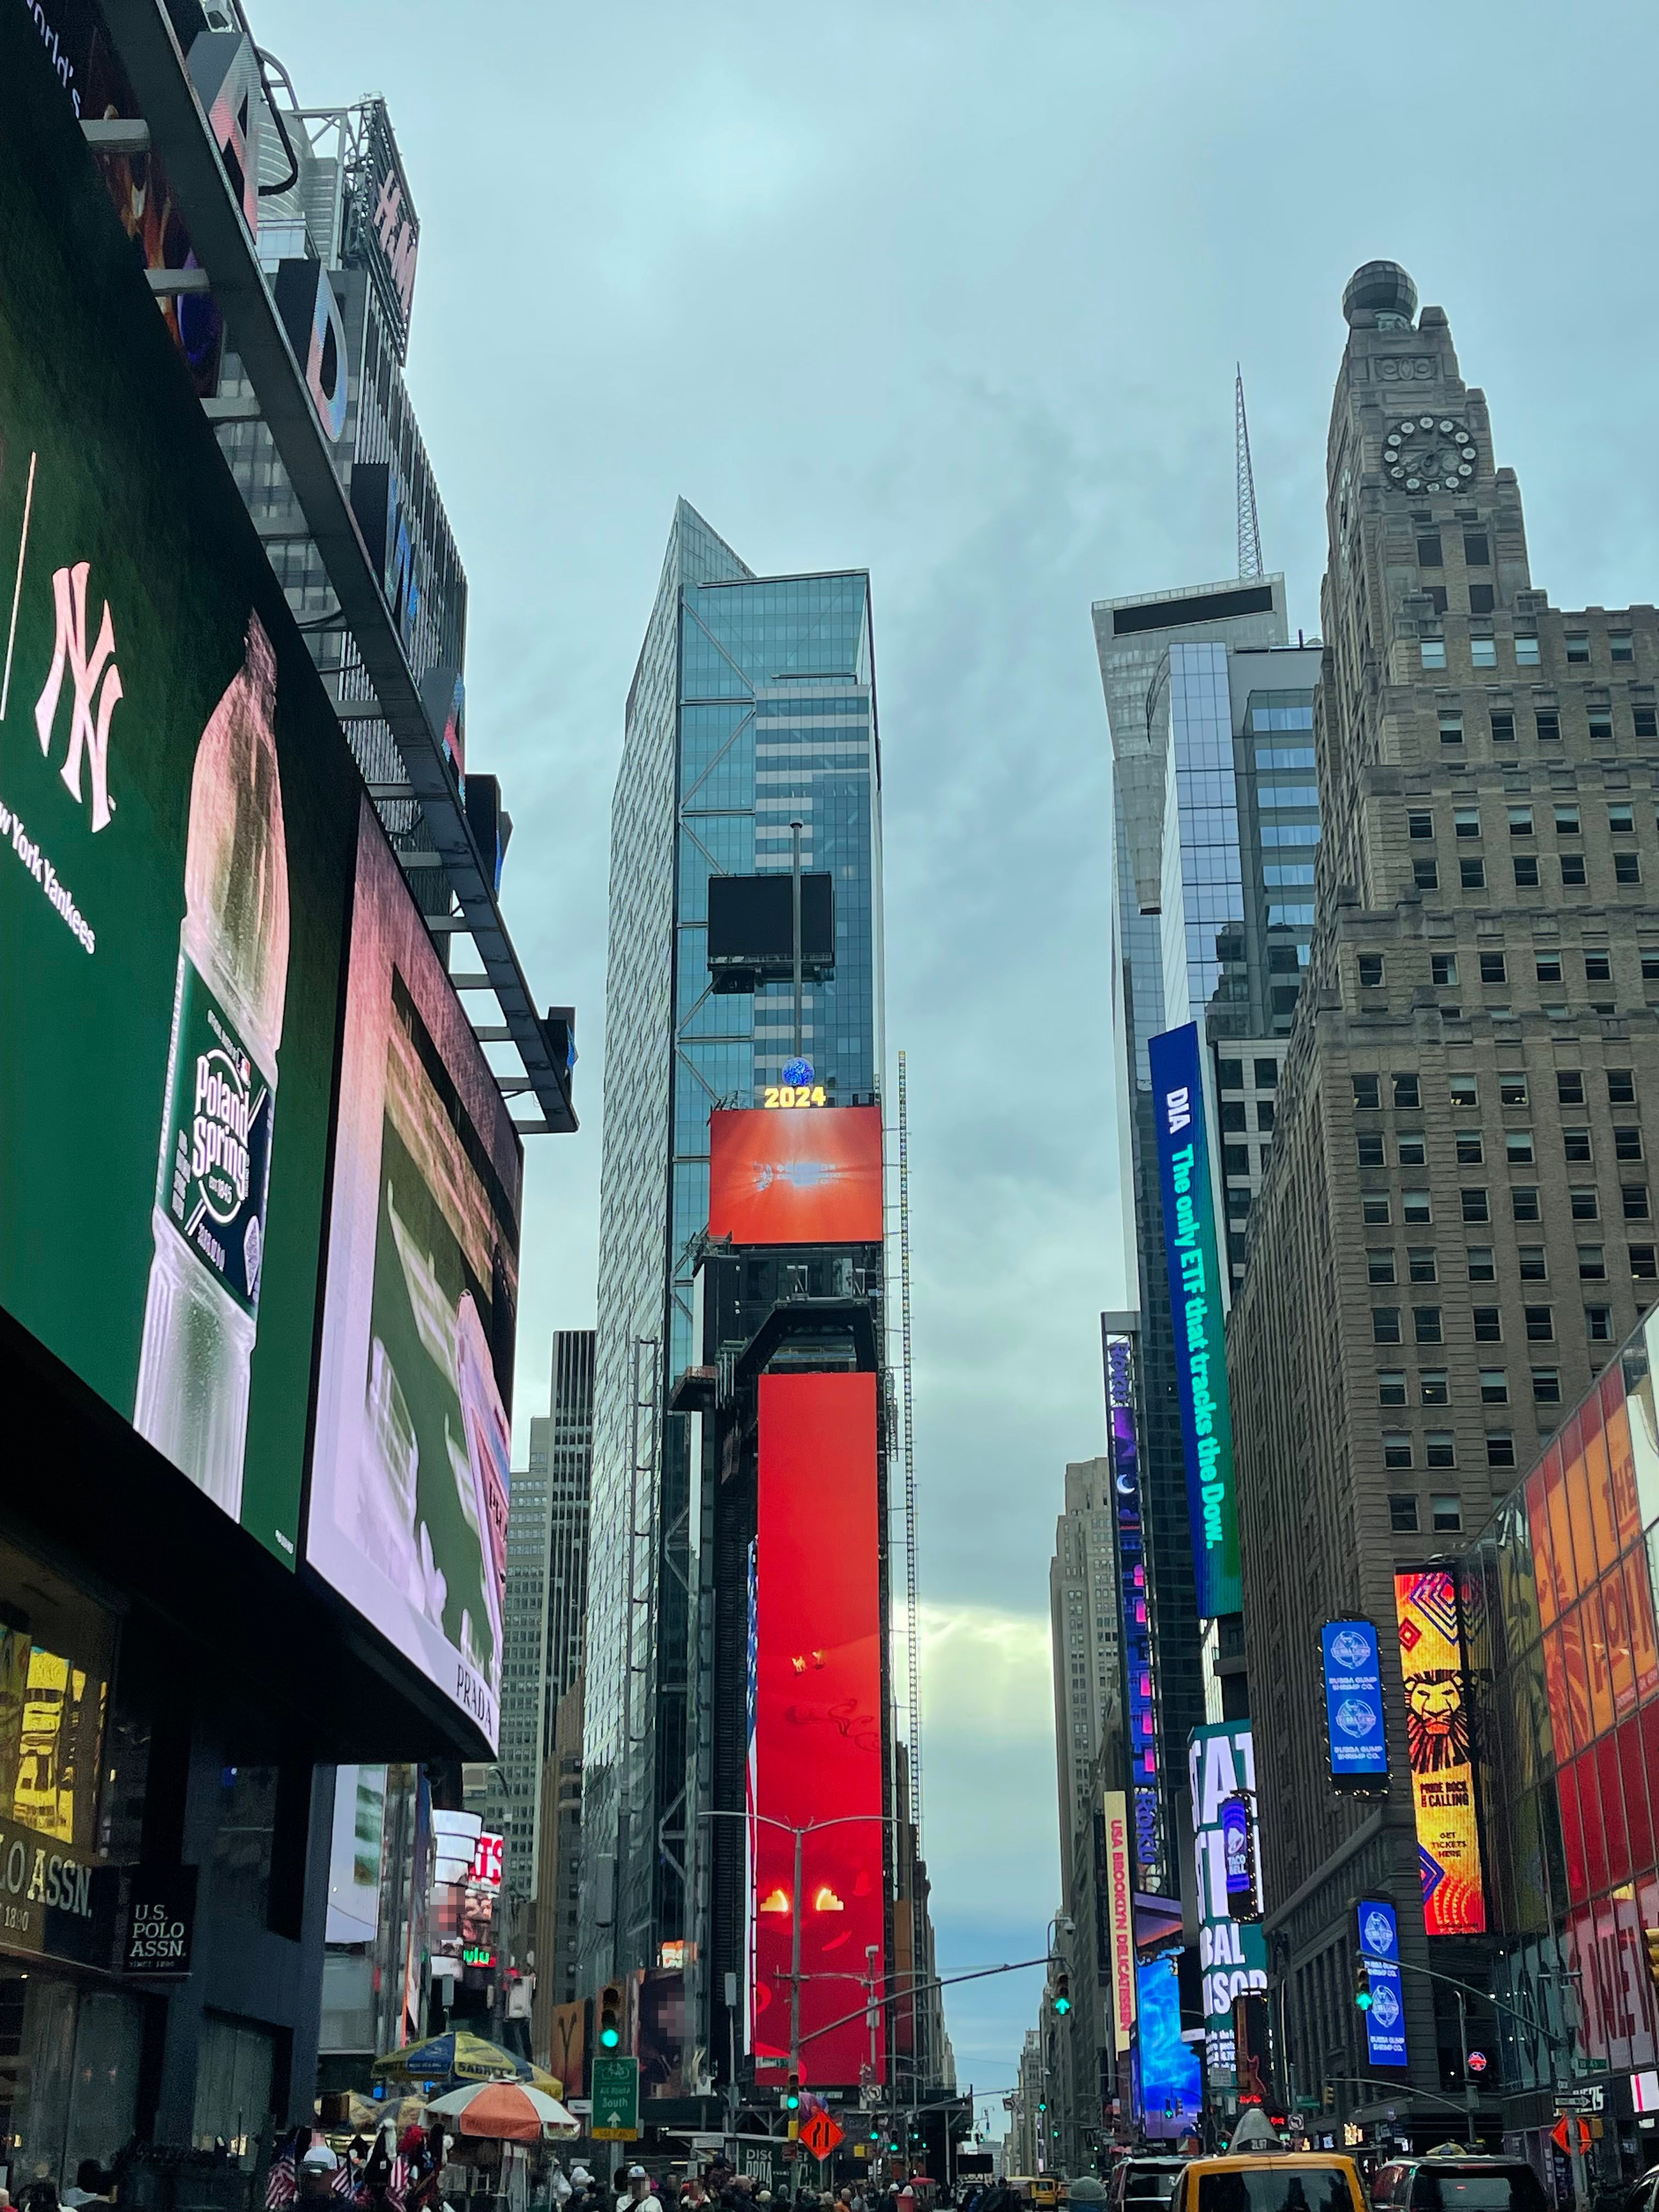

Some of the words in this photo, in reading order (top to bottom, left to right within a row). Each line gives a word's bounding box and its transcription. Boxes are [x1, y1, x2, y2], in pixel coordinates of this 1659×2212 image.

[27, 0, 81, 120] orld's
[34, 561, 123, 833] NY
[12, 813, 44, 883] York
[43, 858, 95, 955] Yankees
[194, 1055, 250, 1148] Poland
[765, 1085, 826, 1108] 2024
[1166, 1086, 1190, 1135] DIA
[193, 1115, 248, 1201] Spring
[1171, 1143, 1194, 1193] The
[1174, 1194, 1201, 1247] only
[1181, 1249, 1206, 1293] ETF
[1185, 1294, 1209, 1352] that
[1189, 1353, 1216, 1436] tracks
[1197, 1436, 1221, 1482] the
[1201, 1482, 1224, 1549] Dow.
[456, 1663, 493, 1737] PRADA
[1429, 1793, 1469, 1807] CALLING
[27, 1849, 92, 1919] ASSN.
[1227, 1854, 1246, 1866] TACO
[1229, 1864, 1247, 1875] BELL
[135, 1904, 168, 1921] U.S.
[1113, 1852, 1127, 1931] BROOKLYN
[129, 1940, 187, 1958] ASSN.
[132, 1922, 185, 1939] POLO
[1116, 1934, 1132, 2032] DELICATESSEN
[1370, 2035, 1388, 2044] BUBBA
